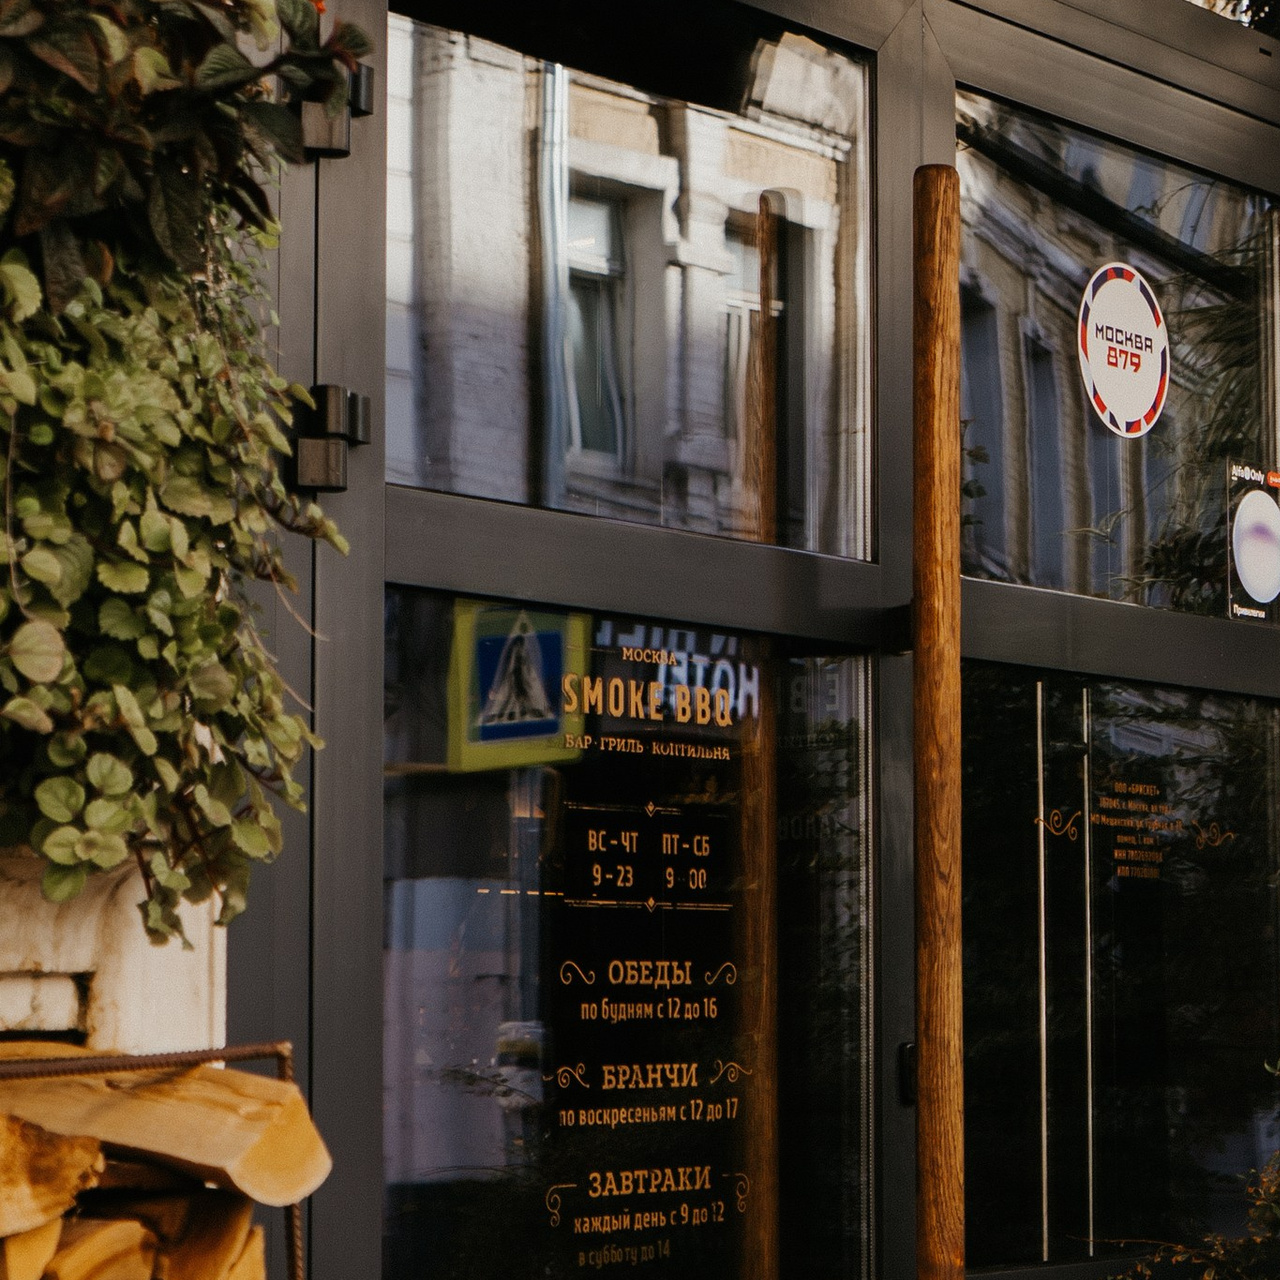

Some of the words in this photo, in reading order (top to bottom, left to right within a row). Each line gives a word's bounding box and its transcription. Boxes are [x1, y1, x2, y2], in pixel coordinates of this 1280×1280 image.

[1095, 322, 1153, 354] МОСКВА
[1107, 345, 1142, 373] 879
[622, 647, 677, 666] МОСКВА
[561, 673, 665, 722] SMOKE
[674, 683, 734, 727] BBQ
[565, 734, 592, 751] БАР
[600, 737, 645, 755] ГРИЛЬ
[608, 960, 692, 990] ОБЕДЫ
[581, 1002, 598, 1020] по
[601, 997, 654, 1024] будням
[657, 1003, 664, 1019] с
[667, 997, 681, 1019] 12
[684, 1002, 700, 1020] до
[703, 996, 718, 1018] 16
[601, 1063, 699, 1090] БРАНЧИ
[559, 1109, 575, 1126] по
[579, 1105, 676, 1129] воскресеньям
[680, 1105, 687, 1121] с
[690, 1099, 703, 1120] 12
[706, 1103, 722, 1122] до
[726, 1097, 739, 1119] 17
[588, 1165, 711, 1199] ЗАВТРАКИ
[573, 1207, 631, 1234] каждый
[633, 1211, 667, 1231] день
[670, 1210, 677, 1226] с
[680, 1202, 689, 1225] 9
[692, 1207, 708, 1227] до
[578, 1251, 586, 1266] в
[588, 1243, 637, 1270] субботу
[641, 1245, 654, 1262] до
[657, 1239, 670, 1259] 14
